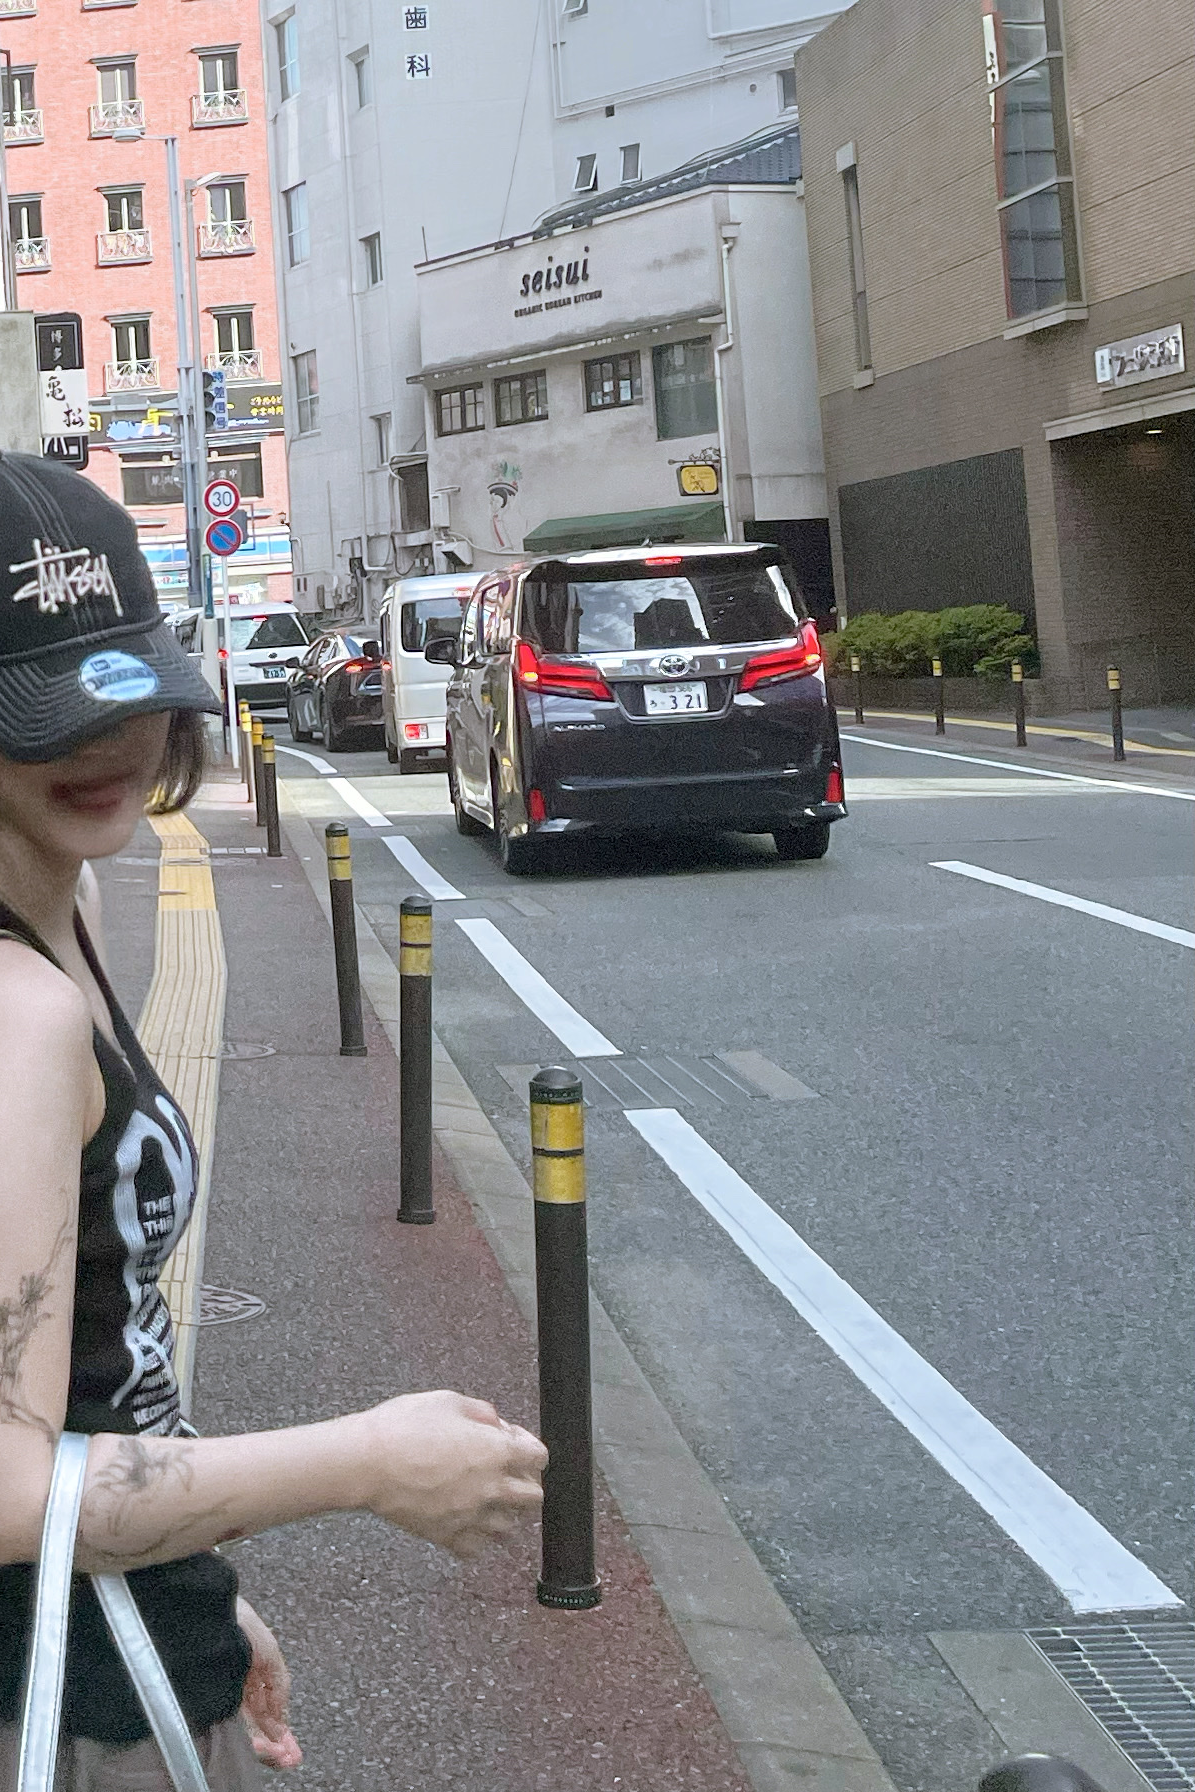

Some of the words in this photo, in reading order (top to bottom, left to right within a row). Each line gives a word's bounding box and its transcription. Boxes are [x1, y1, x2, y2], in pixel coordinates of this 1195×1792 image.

[404, 6, 431, 78] 歯科
[519, 245, 590, 297] seisui
[212, 491, 232, 507] 30
